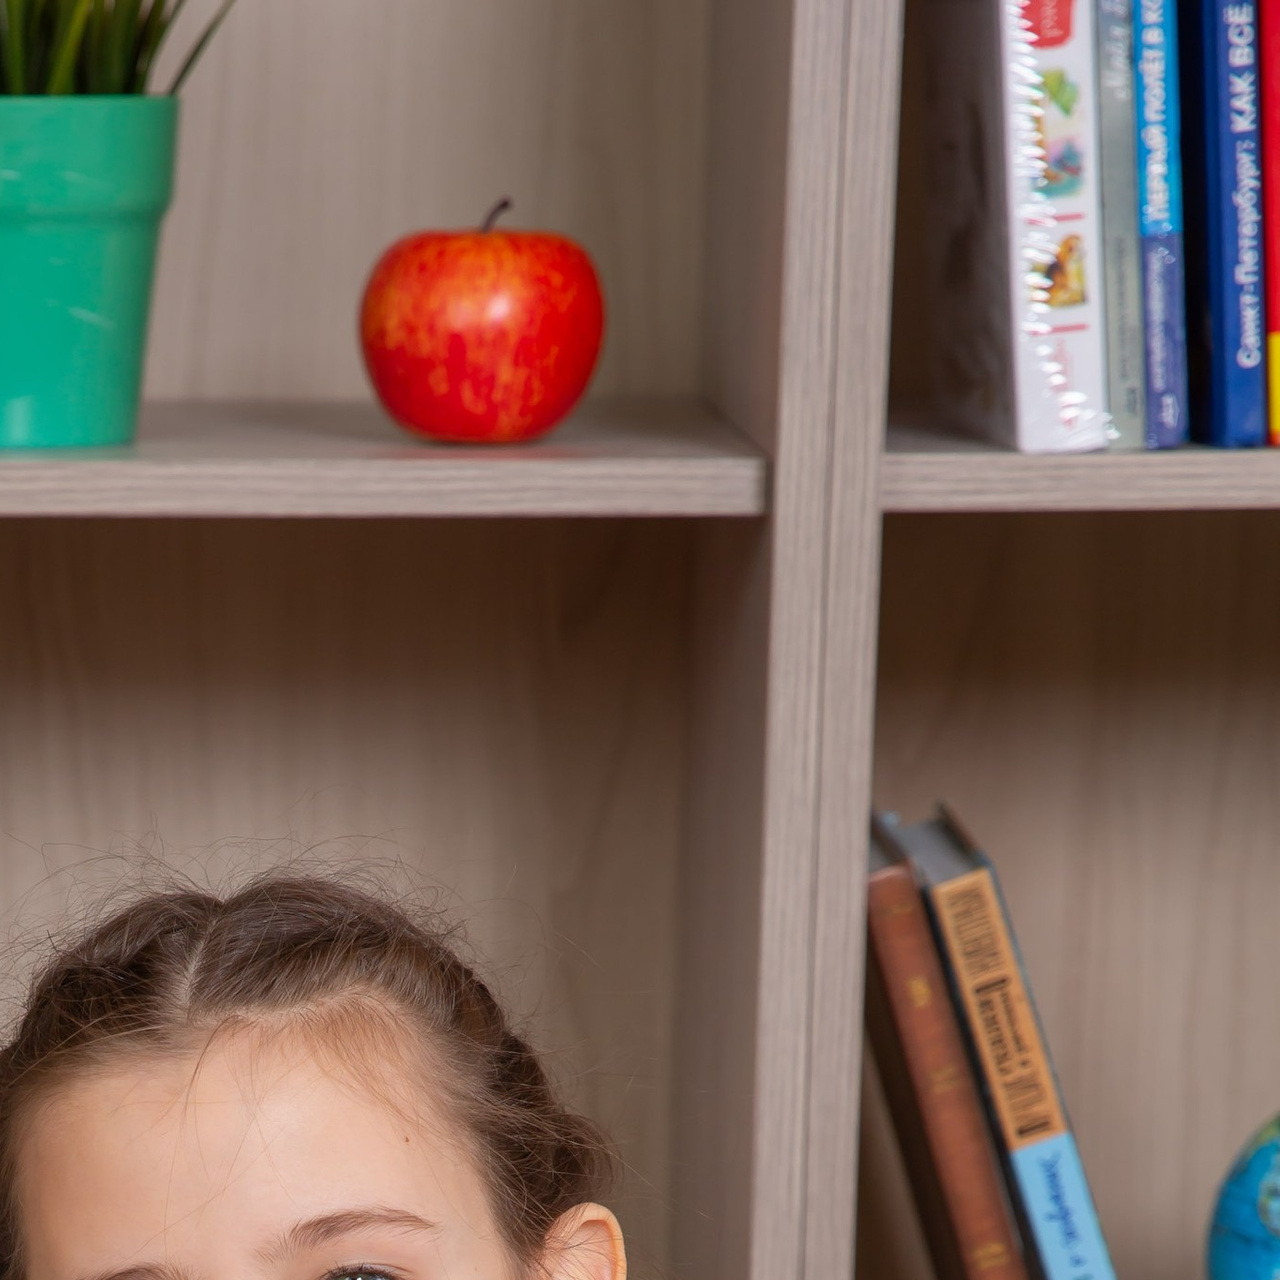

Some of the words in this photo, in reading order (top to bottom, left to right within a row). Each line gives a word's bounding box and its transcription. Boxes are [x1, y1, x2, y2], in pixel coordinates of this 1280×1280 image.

[1142, 28, 1163, 44] В
[1223, 3, 1255, 68] ВСЁ
[1227, 70, 1256, 132] КАК
